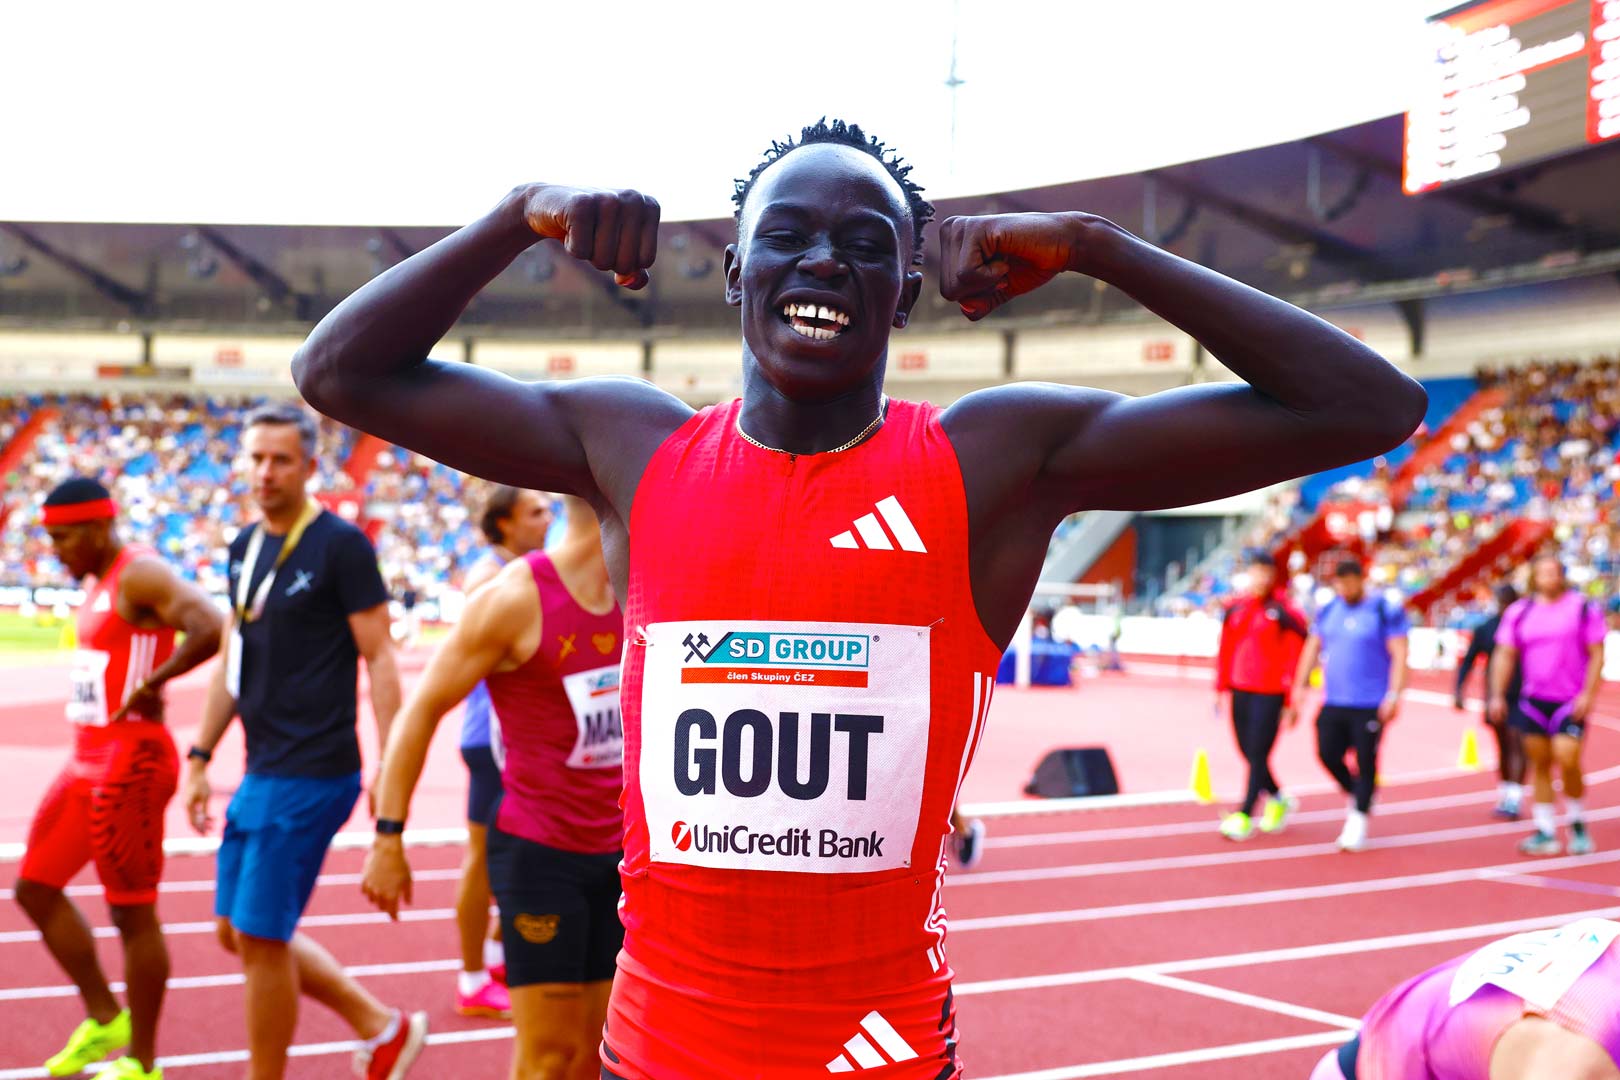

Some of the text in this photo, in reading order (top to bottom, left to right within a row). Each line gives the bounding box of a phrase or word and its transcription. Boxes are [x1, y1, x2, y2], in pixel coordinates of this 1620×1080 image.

[729, 637, 862, 661] SD GROUP
[726, 671, 815, 683] člen Skupiny ČEZ
[583, 707, 622, 747] MA
[674, 708, 884, 800] GOUT
[693, 824, 885, 858] UniCredit Bank
